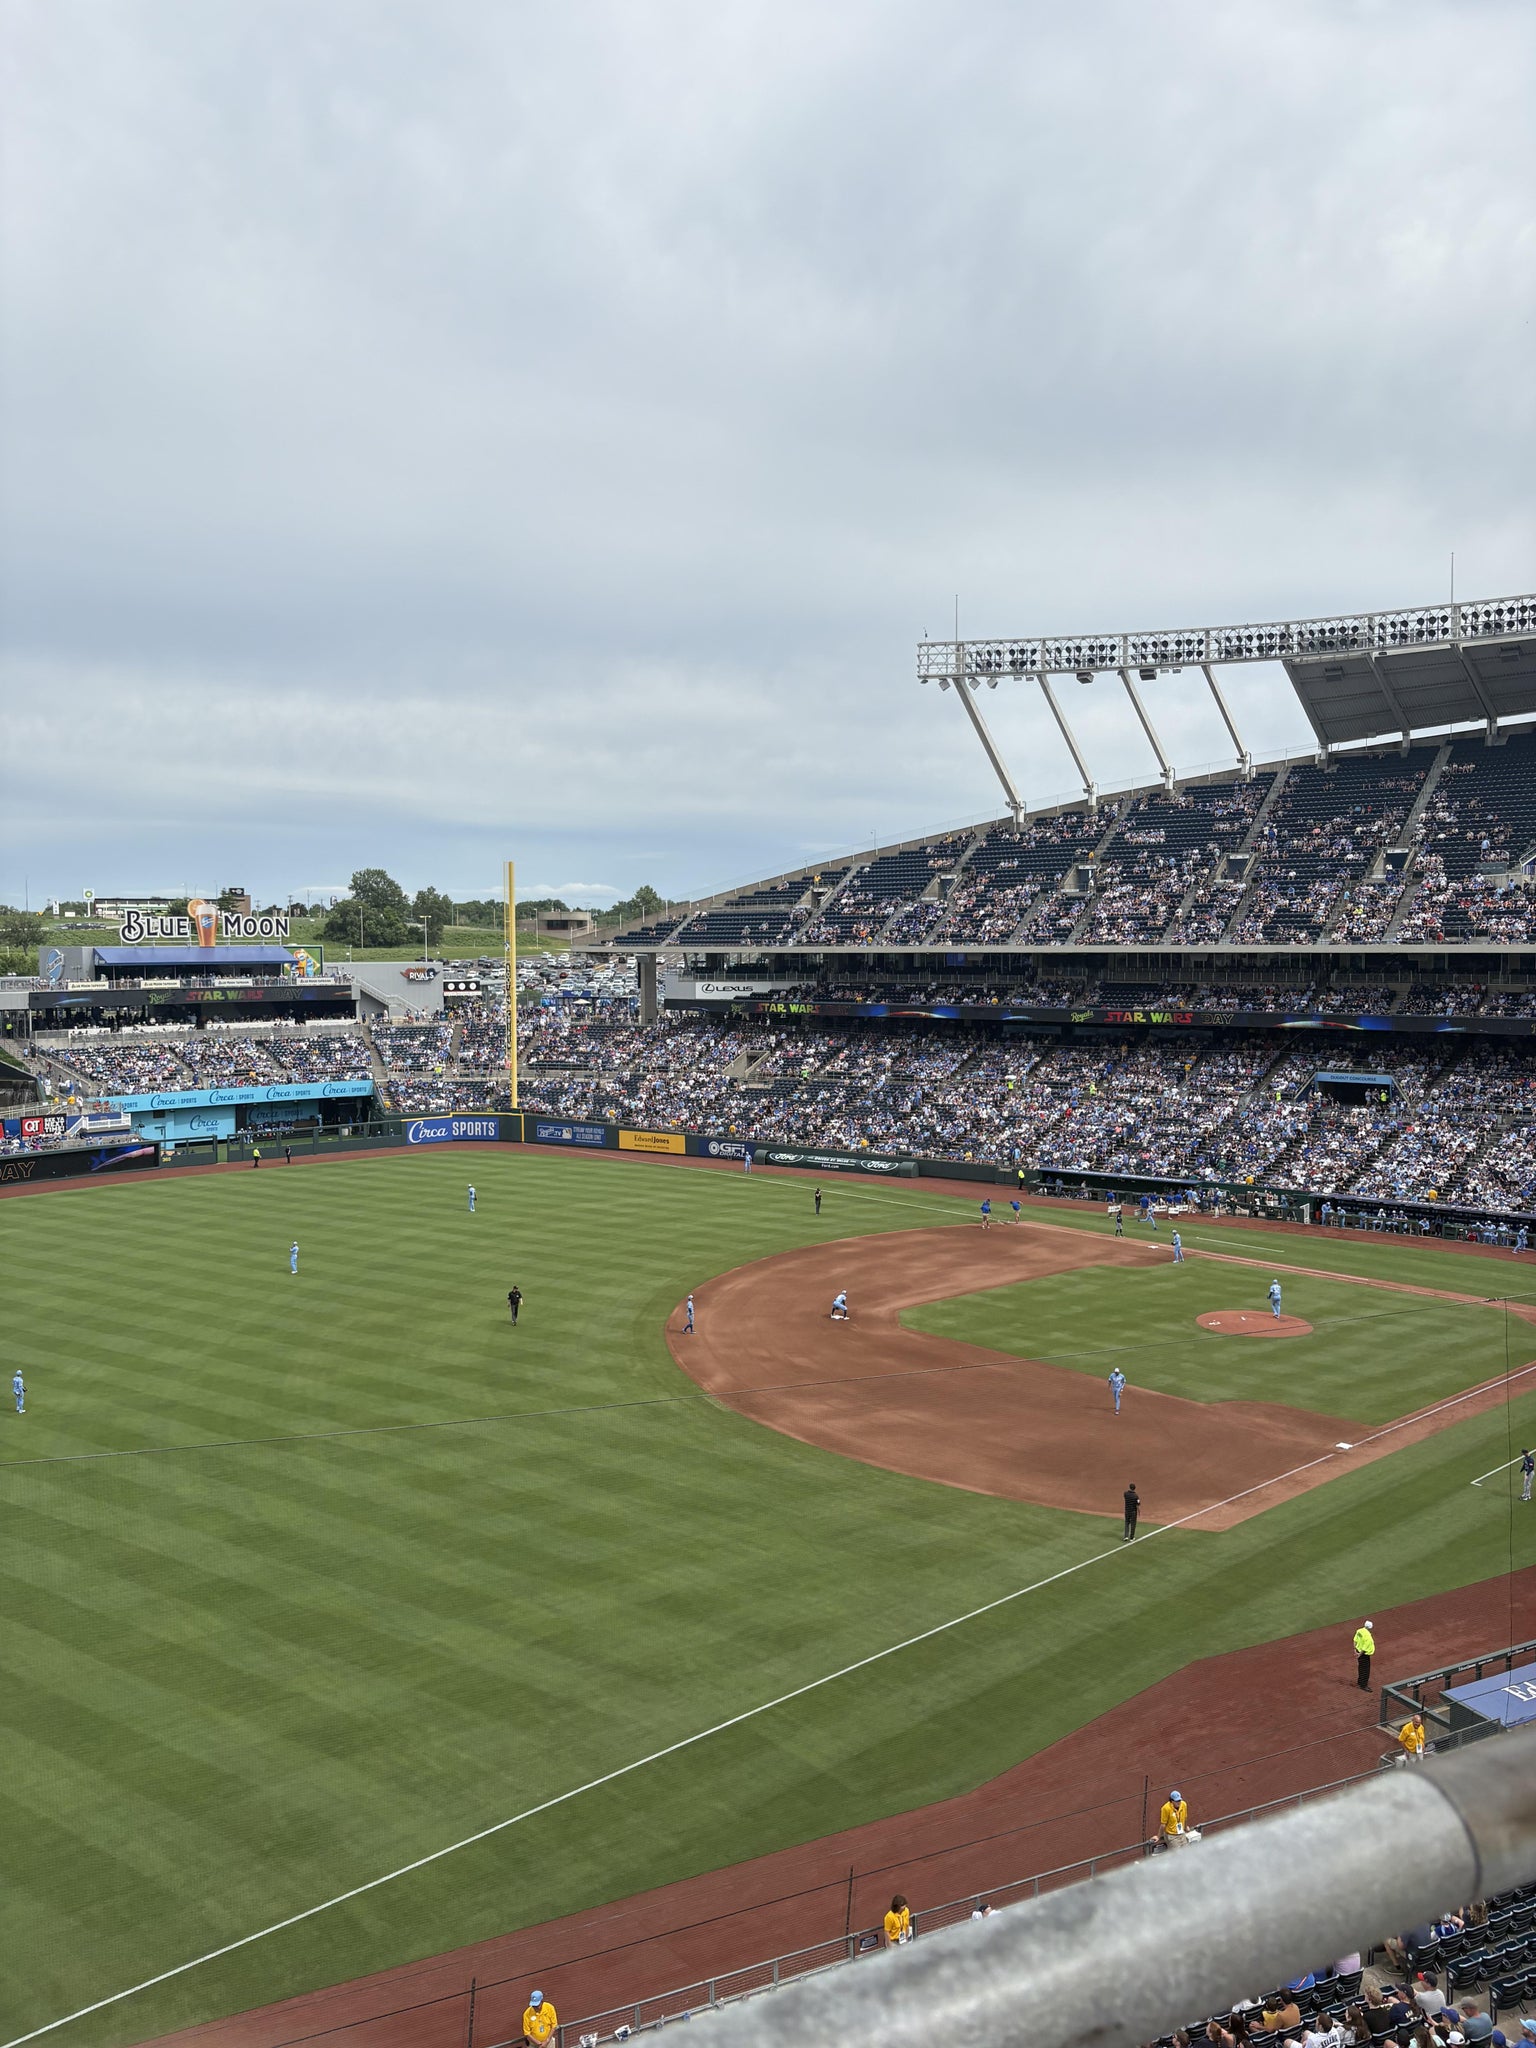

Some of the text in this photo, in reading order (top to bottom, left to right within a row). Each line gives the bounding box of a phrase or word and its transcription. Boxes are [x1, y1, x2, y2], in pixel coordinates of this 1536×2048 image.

[121, 910, 289, 942] BLUE MOON
[409, 972, 434, 980] RIVALS
[186, 991, 225, 1001] STAR
[226, 990, 264, 1000] WARS
[755, 1003, 787, 1012] STAR
[789, 1004, 820, 1013] WARS
[1071, 1010, 1234, 1025] Royals STAR WARS DAY
[266, 1087, 292, 1100] Circa
[322, 1083, 347, 1096] Circa
[151, 1094, 177, 1109] Circa
[209, 1090, 235, 1104] Circa
[24, 1120, 40, 1133] QT
[189, 1115, 219, 1130] Circa
[408, 1120, 495, 1143] Circa SPORTS
[774, 1153, 798, 1161] Ford
[0, 1161, 36, 1180] AY
[866, 1160, 891, 1169] Ford
